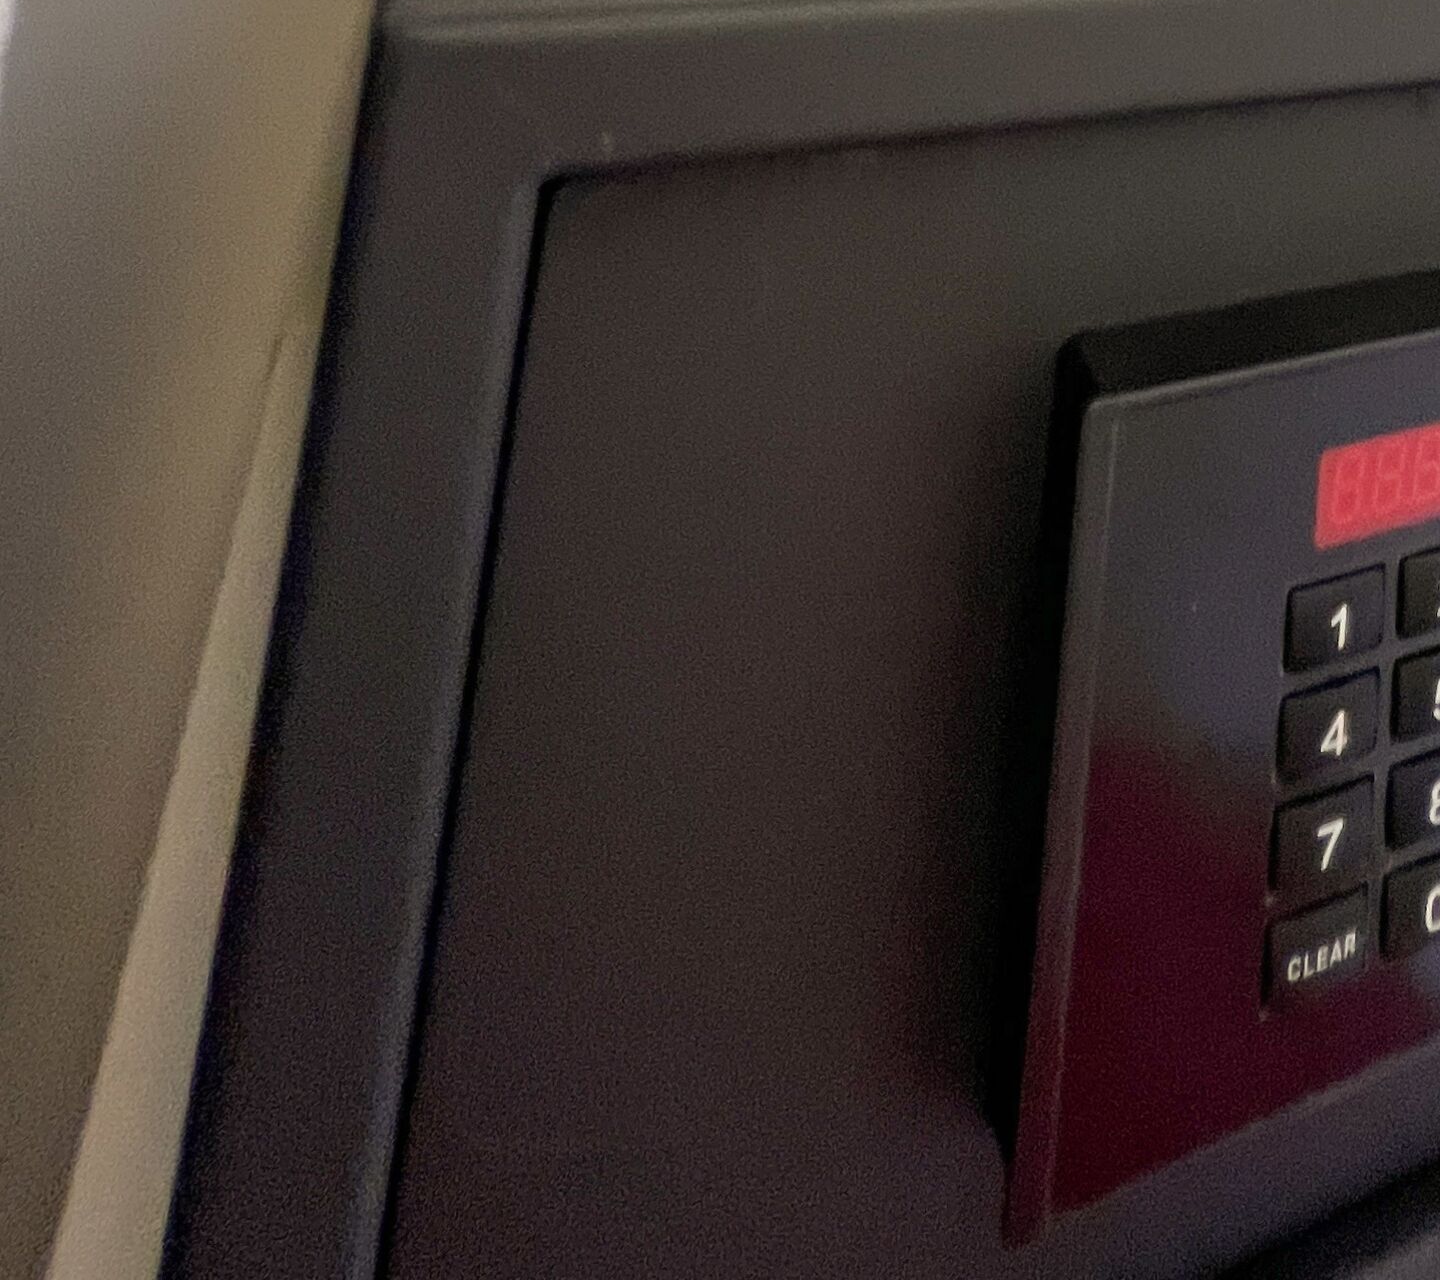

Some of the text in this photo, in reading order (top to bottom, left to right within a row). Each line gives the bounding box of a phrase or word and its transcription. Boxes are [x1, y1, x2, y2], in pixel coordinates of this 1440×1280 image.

[1330, 602, 1348, 651] 1
[1320, 709, 1348, 757] 4
[1316, 817, 1344, 872] 7
[1287, 930, 1357, 982] CLEAR
